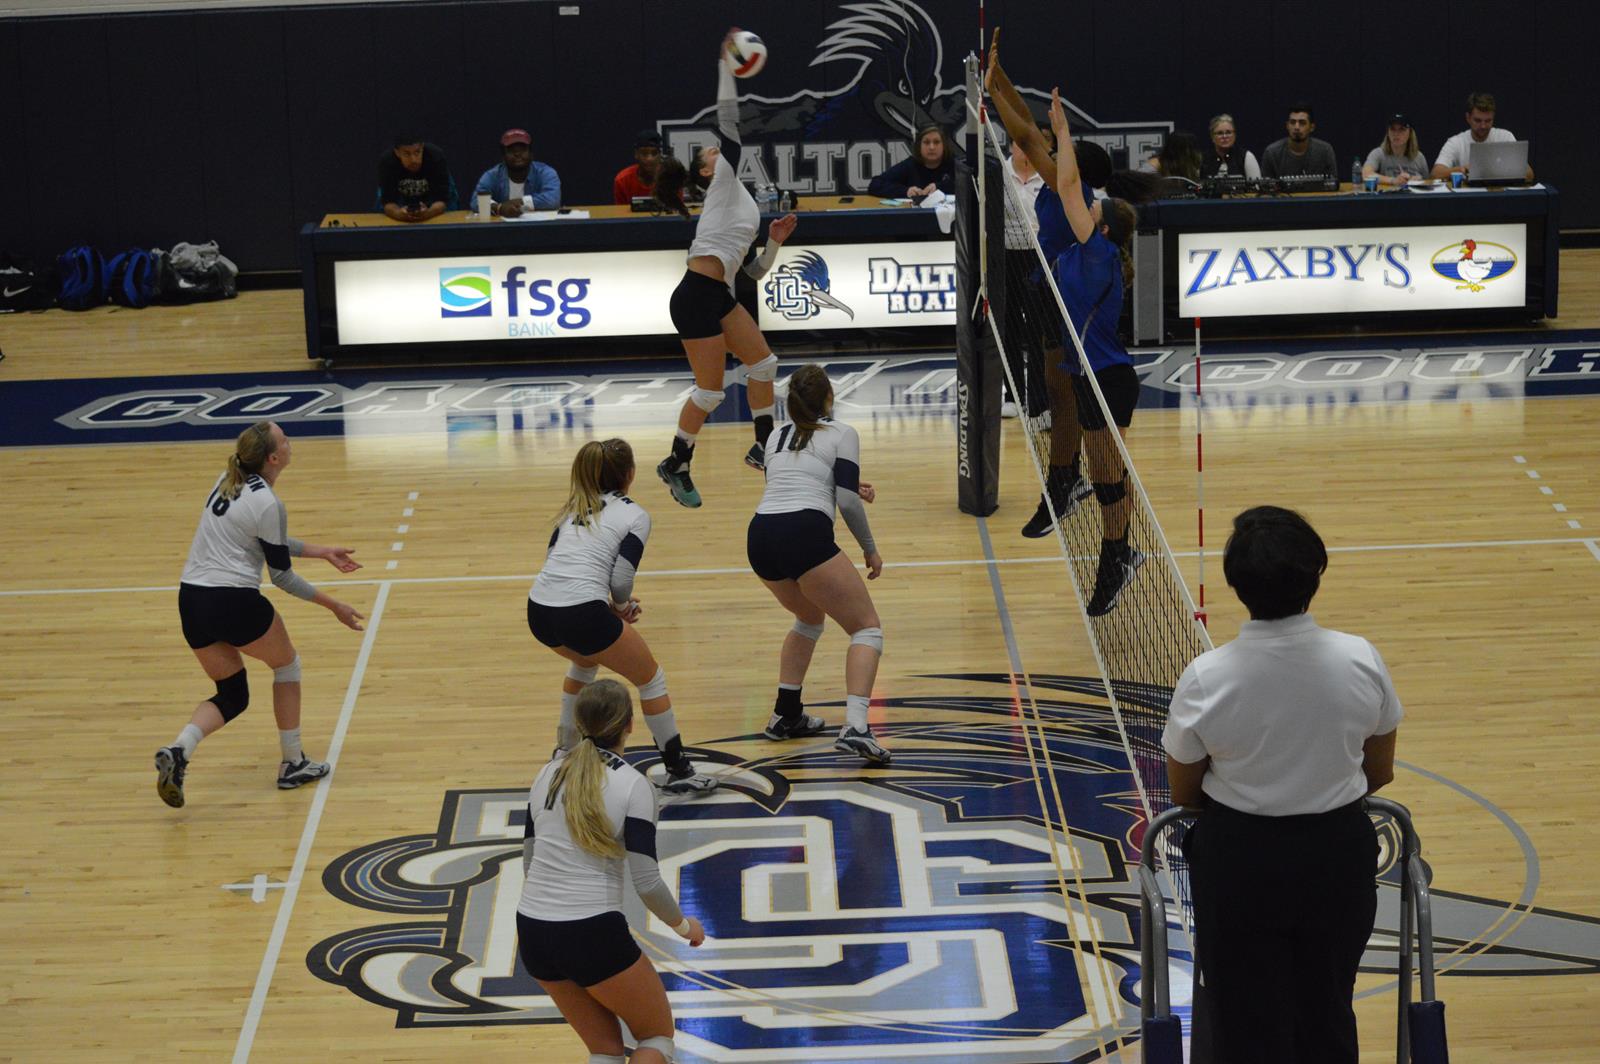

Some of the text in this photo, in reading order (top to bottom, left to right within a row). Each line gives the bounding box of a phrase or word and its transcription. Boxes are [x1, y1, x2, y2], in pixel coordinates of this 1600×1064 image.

[502, 266, 591, 329] fsg
[869, 257, 956, 295] DALT
[1184, 243, 1411, 299] ZAXBY'S
[508, 322, 556, 337] BANK
[958, 380, 971, 479] SPALDING
